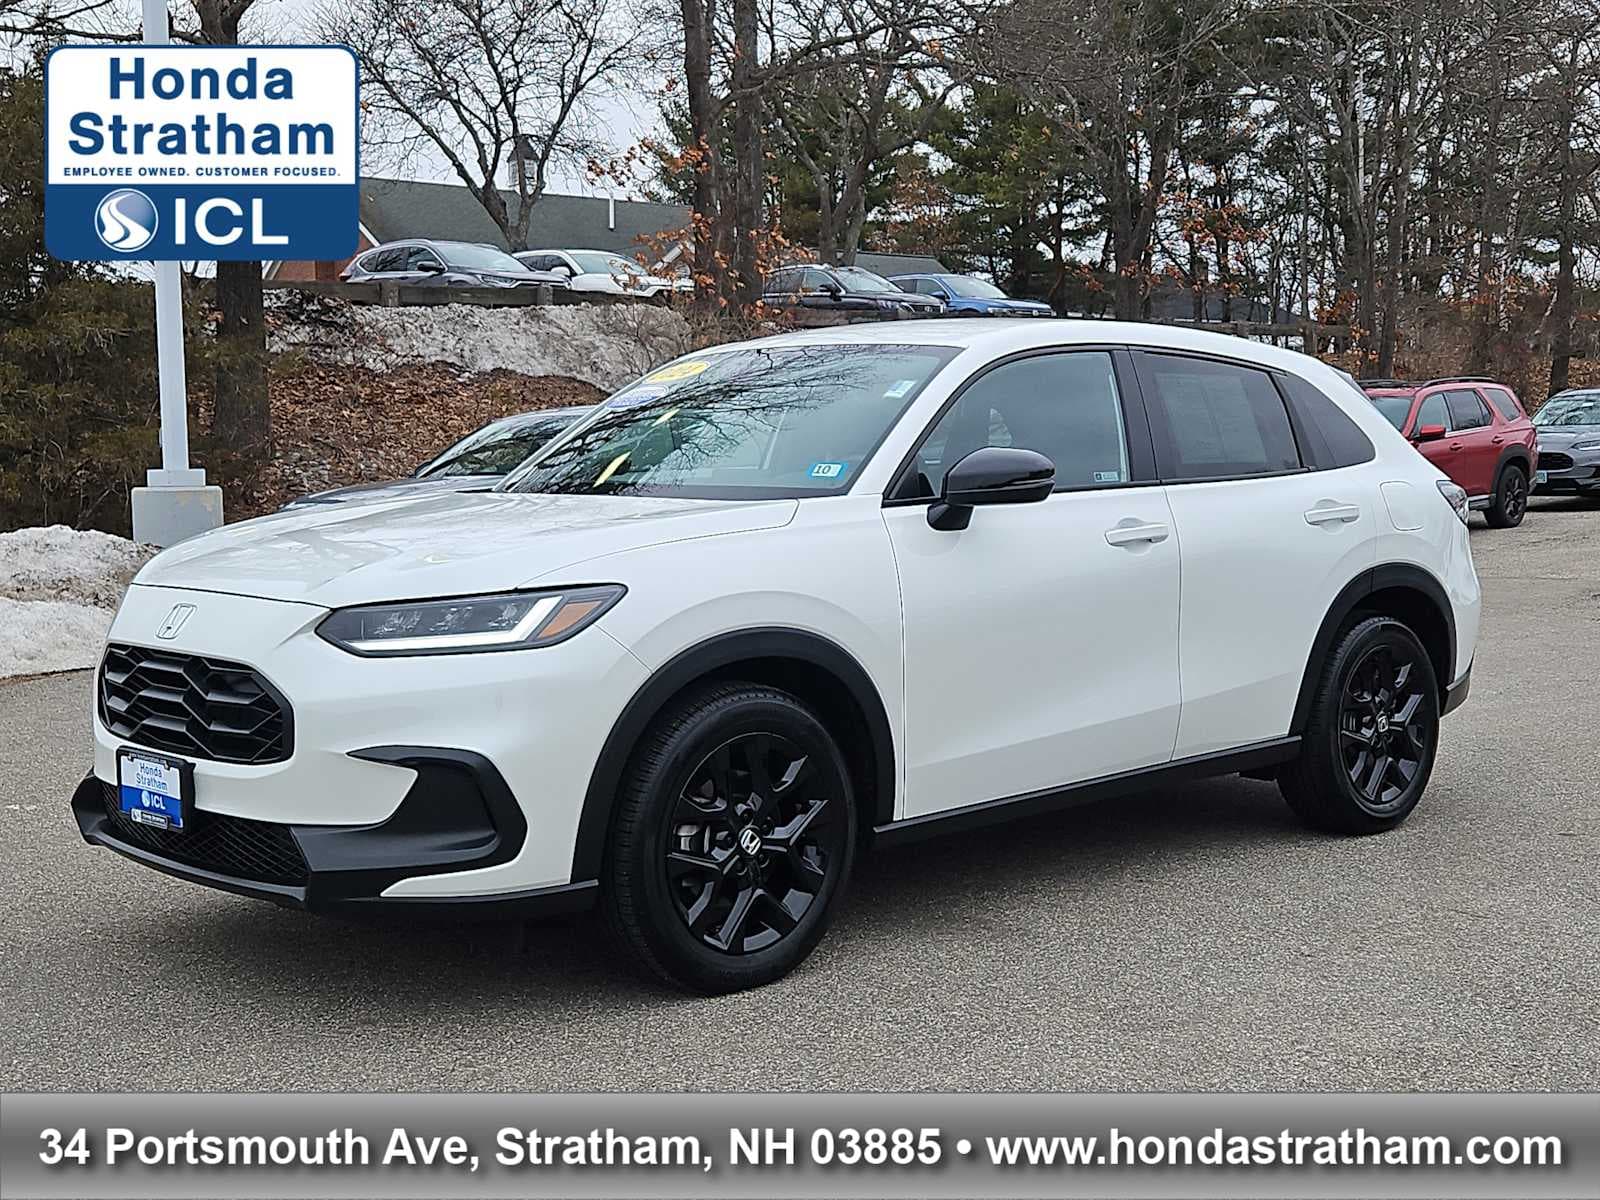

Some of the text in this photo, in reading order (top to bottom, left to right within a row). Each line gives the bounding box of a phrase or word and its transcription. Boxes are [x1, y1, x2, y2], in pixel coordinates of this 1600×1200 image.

[813, 465, 832, 475] 10
[140, 762, 162, 778] Honda
[136, 772, 168, 791] Stratham
[150, 793, 166, 810] ICL
